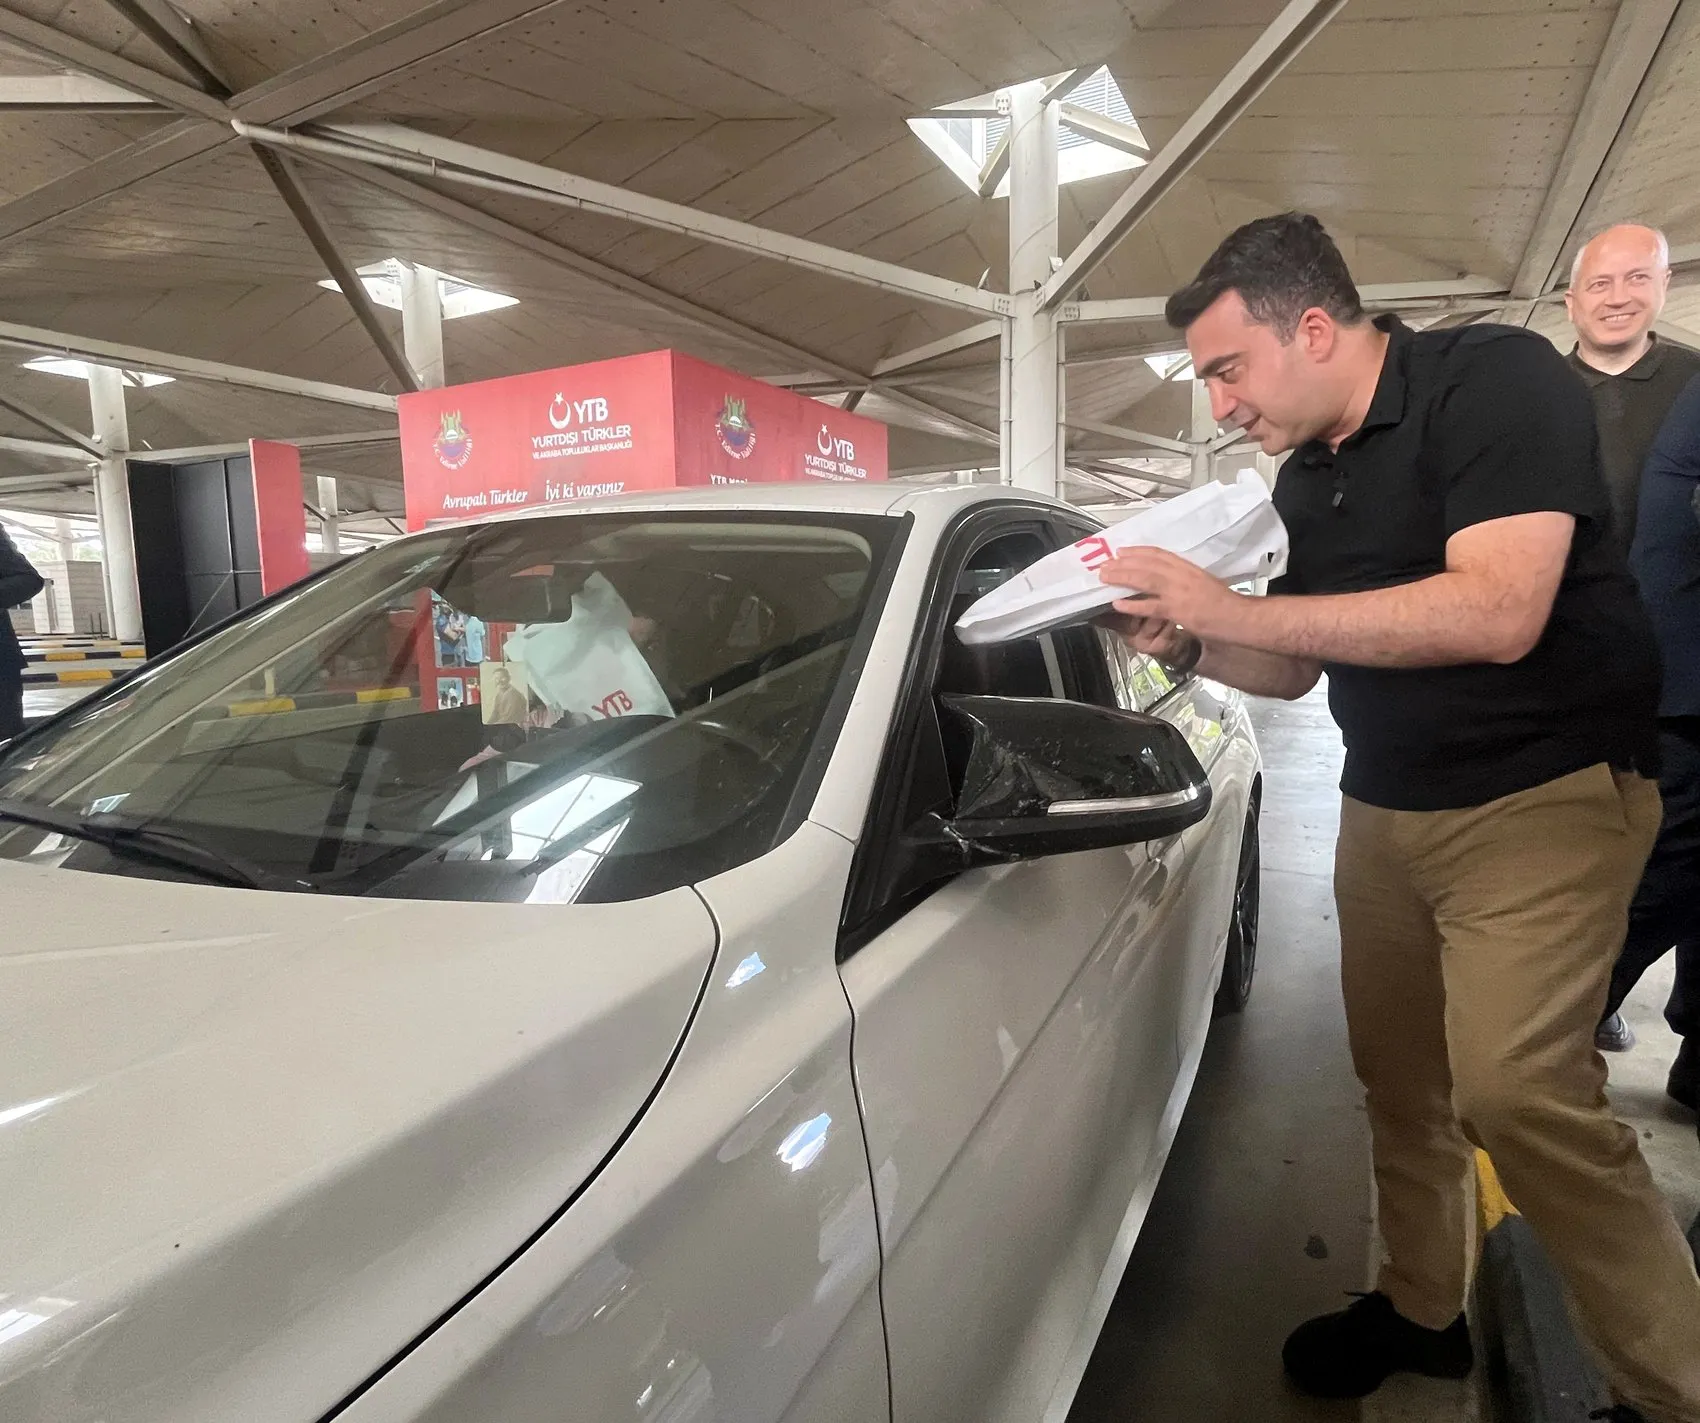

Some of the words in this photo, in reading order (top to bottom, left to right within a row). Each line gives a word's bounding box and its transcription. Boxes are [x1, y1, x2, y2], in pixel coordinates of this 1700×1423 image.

[573, 397, 609, 424] YTB
[531, 431, 579, 449] YURTDIŞI
[581, 425, 632, 443] TÜRKLER
[833, 437, 855, 461] YTB
[838, 461, 867, 479] TÜRKLER
[442, 493, 487, 510] Avrupalı
[489, 489, 528, 506] Türkler
[545, 479, 561, 502] İyi
[562, 482, 575, 499] ki
[576, 481, 625, 498] varsınız
[591, 689, 633, 719] YTB
